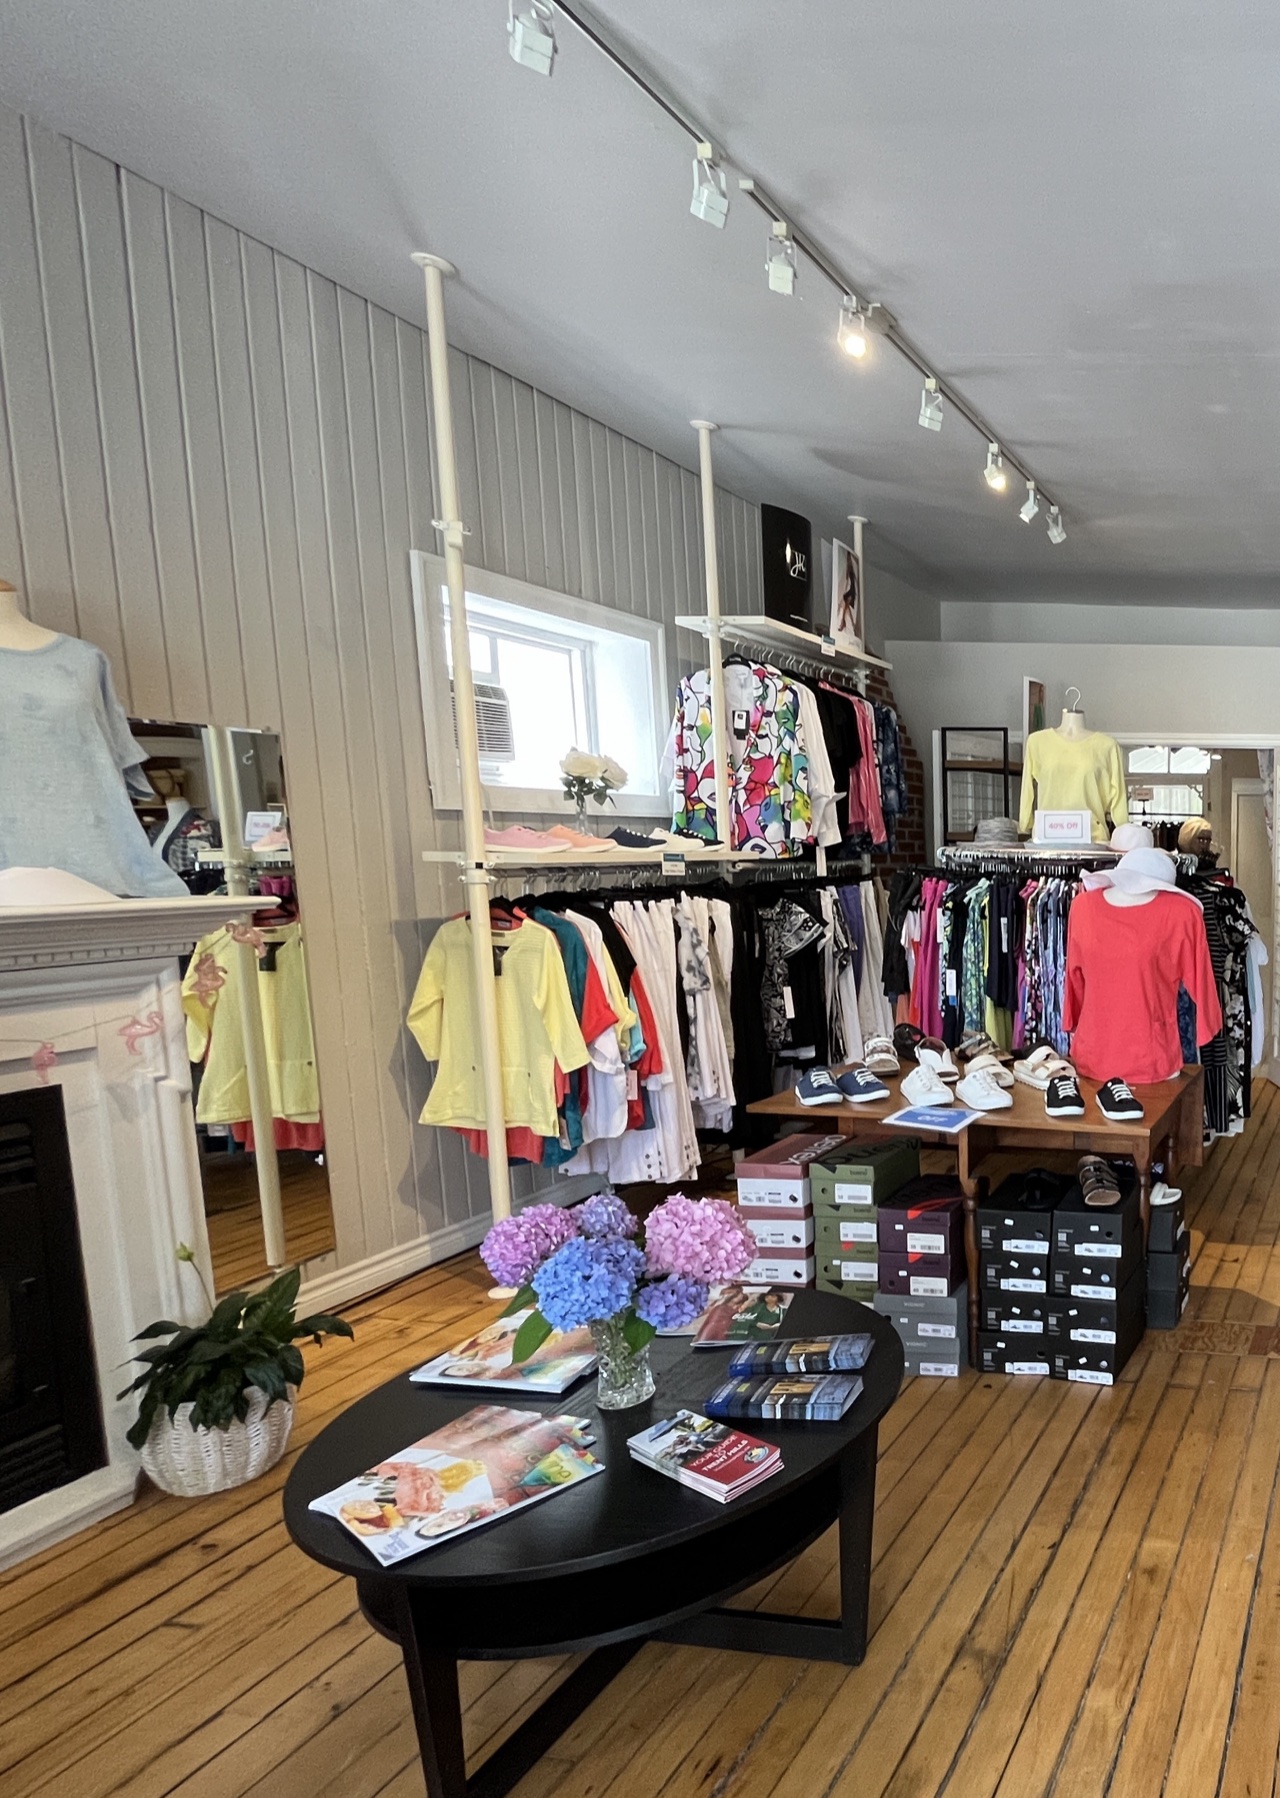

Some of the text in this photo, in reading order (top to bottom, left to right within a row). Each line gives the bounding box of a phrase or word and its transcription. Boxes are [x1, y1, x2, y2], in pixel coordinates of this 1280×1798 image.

[1048, 821, 1079, 830] 40% Off
[690, 1451, 713, 1467] YOUR
[712, 1434, 738, 1453] GUIDE
[701, 1454, 728, 1472] TRENT
[726, 1438, 749, 1457] HILLS
[713, 1449, 727, 1458] TO
